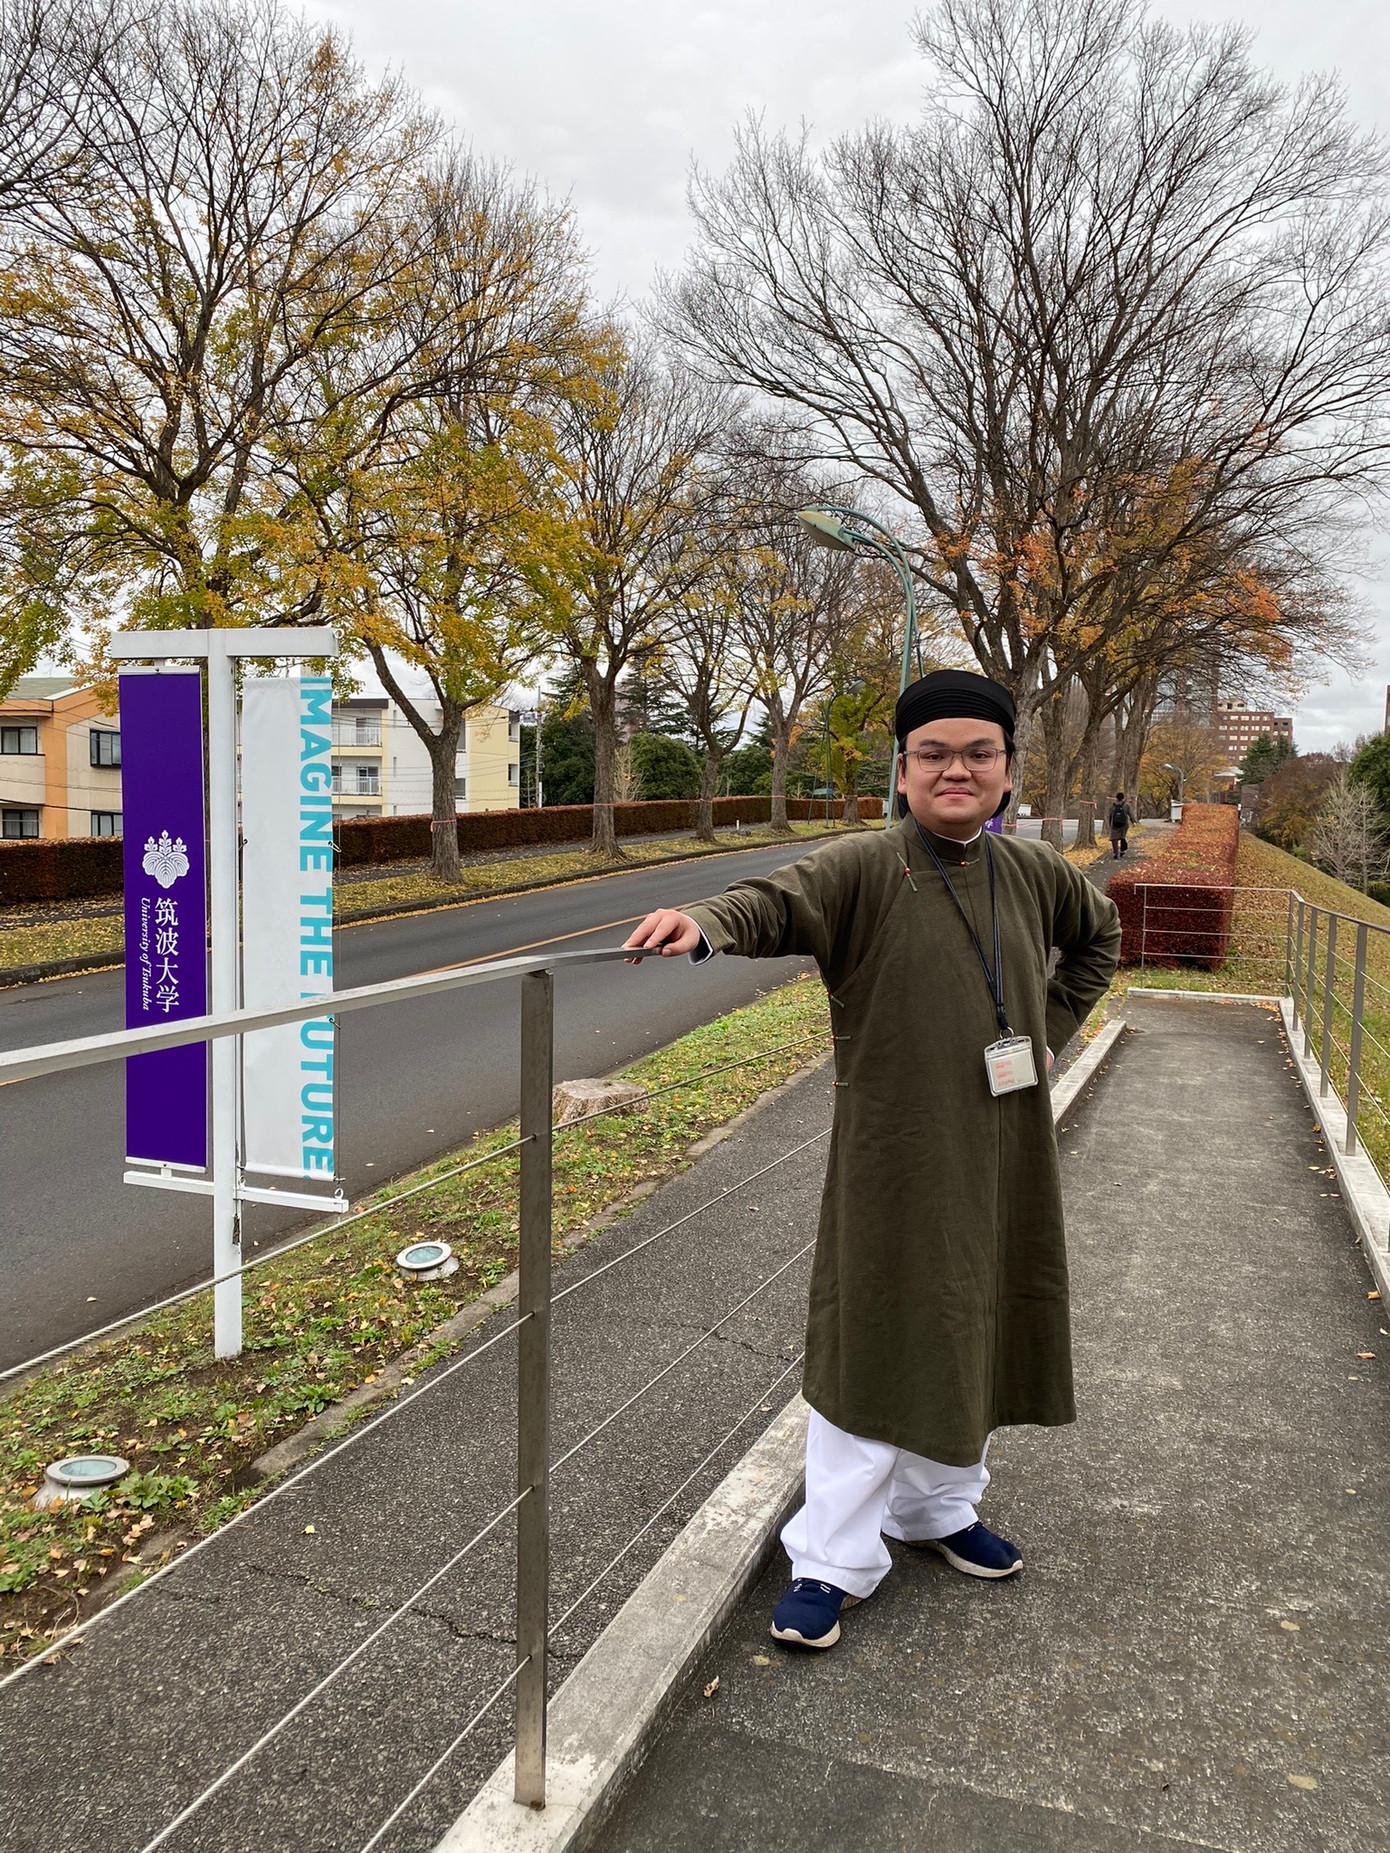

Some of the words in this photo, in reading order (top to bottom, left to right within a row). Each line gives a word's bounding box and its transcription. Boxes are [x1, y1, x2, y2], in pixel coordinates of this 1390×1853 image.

[300, 677, 333, 872] IMAGINE
[139, 897, 151, 952] University
[154, 897, 180, 1013] 筑波大学
[300, 887, 333, 977] THE
[139, 953, 152, 969] of
[142, 967, 152, 1011] Tsukuba
